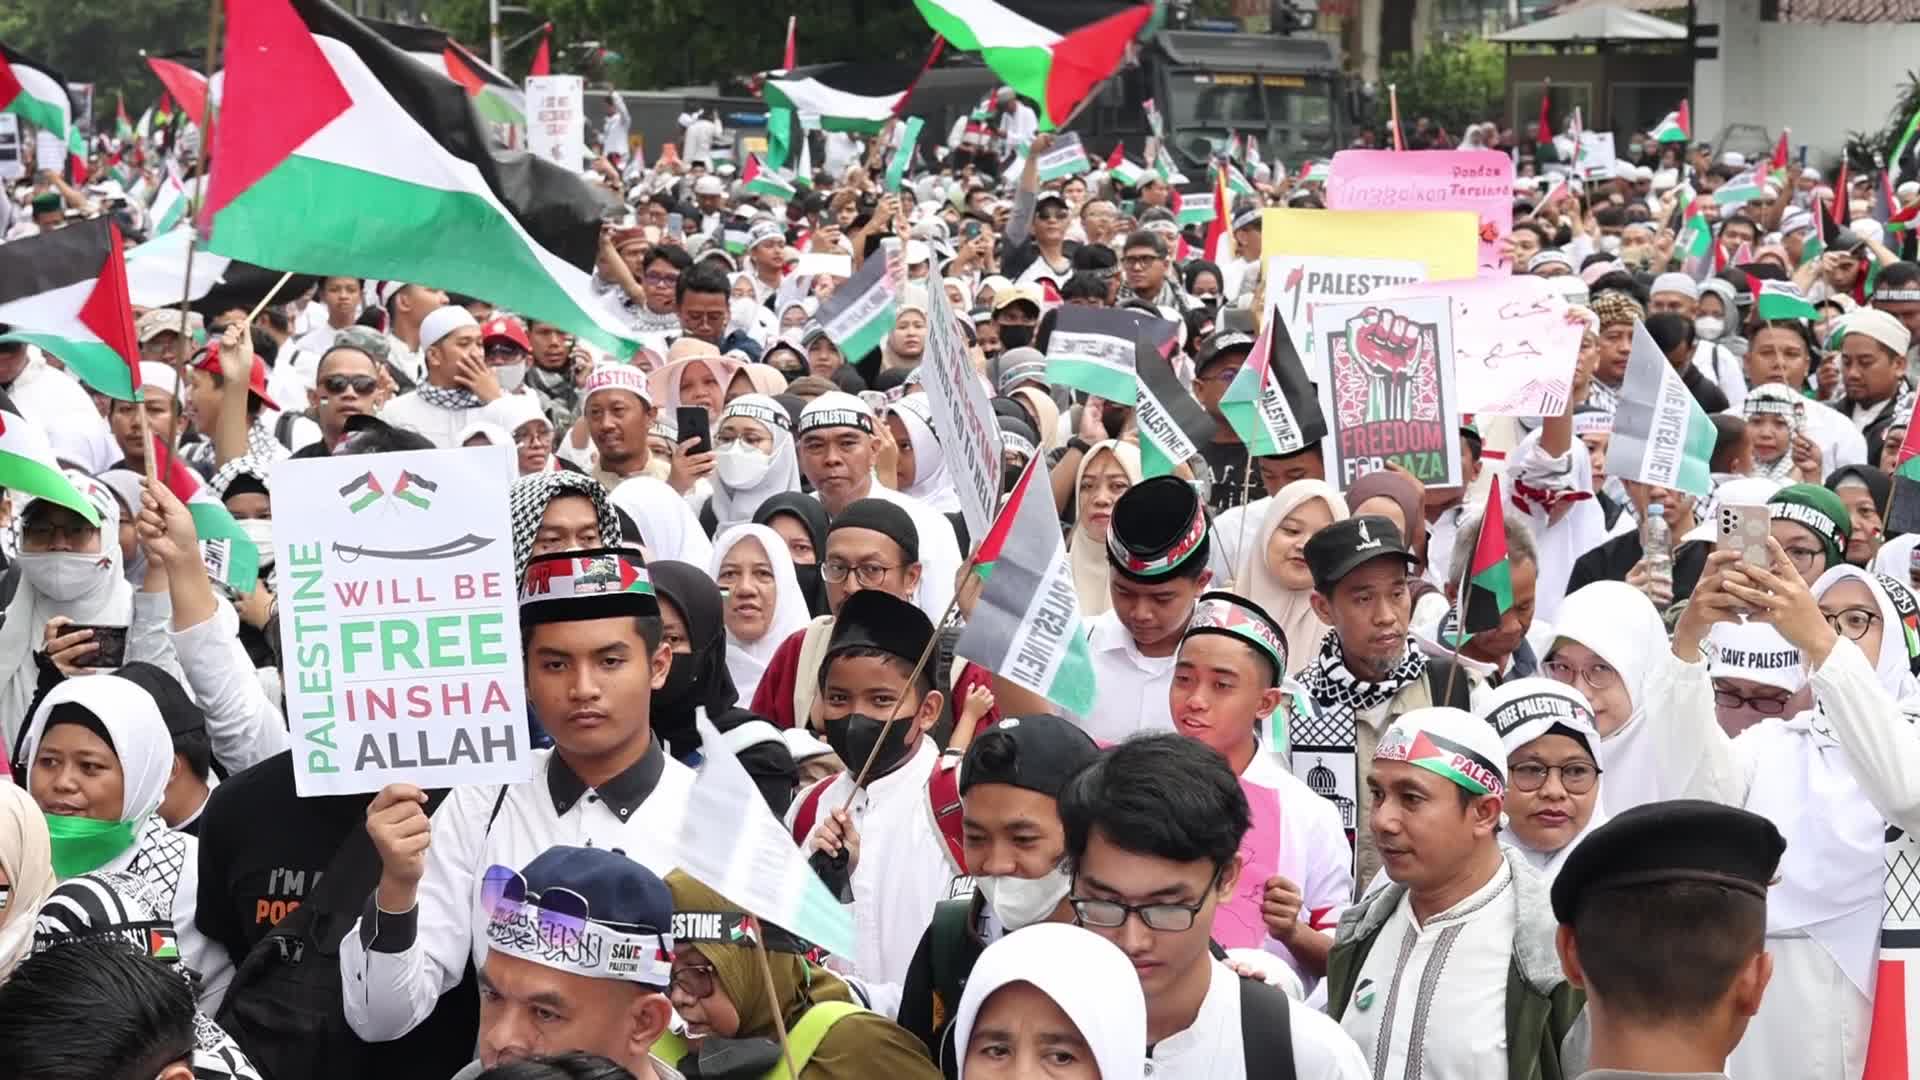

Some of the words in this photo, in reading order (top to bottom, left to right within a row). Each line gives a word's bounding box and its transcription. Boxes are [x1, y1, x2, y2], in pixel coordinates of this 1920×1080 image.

[1341, 420, 1443, 457] FREEDOM
[334, 577, 436, 608] WILL
[454, 572, 502, 600] BE
[289, 541, 340, 775] PALESTINE
[339, 612, 508, 674] FREE
[1721, 647, 1745, 667] SAVE
[1748, 650, 1801, 669] PALESTIN
[345, 680, 511, 722] INSHA
[1496, 703, 1519, 731] FREE
[1517, 696, 1573, 719] PALESTINE
[354, 724, 518, 772] ALLAH
[268, 867, 305, 895] I'M
[608, 962, 638, 973] PALESTINE
[611, 943, 641, 960] SAVE
